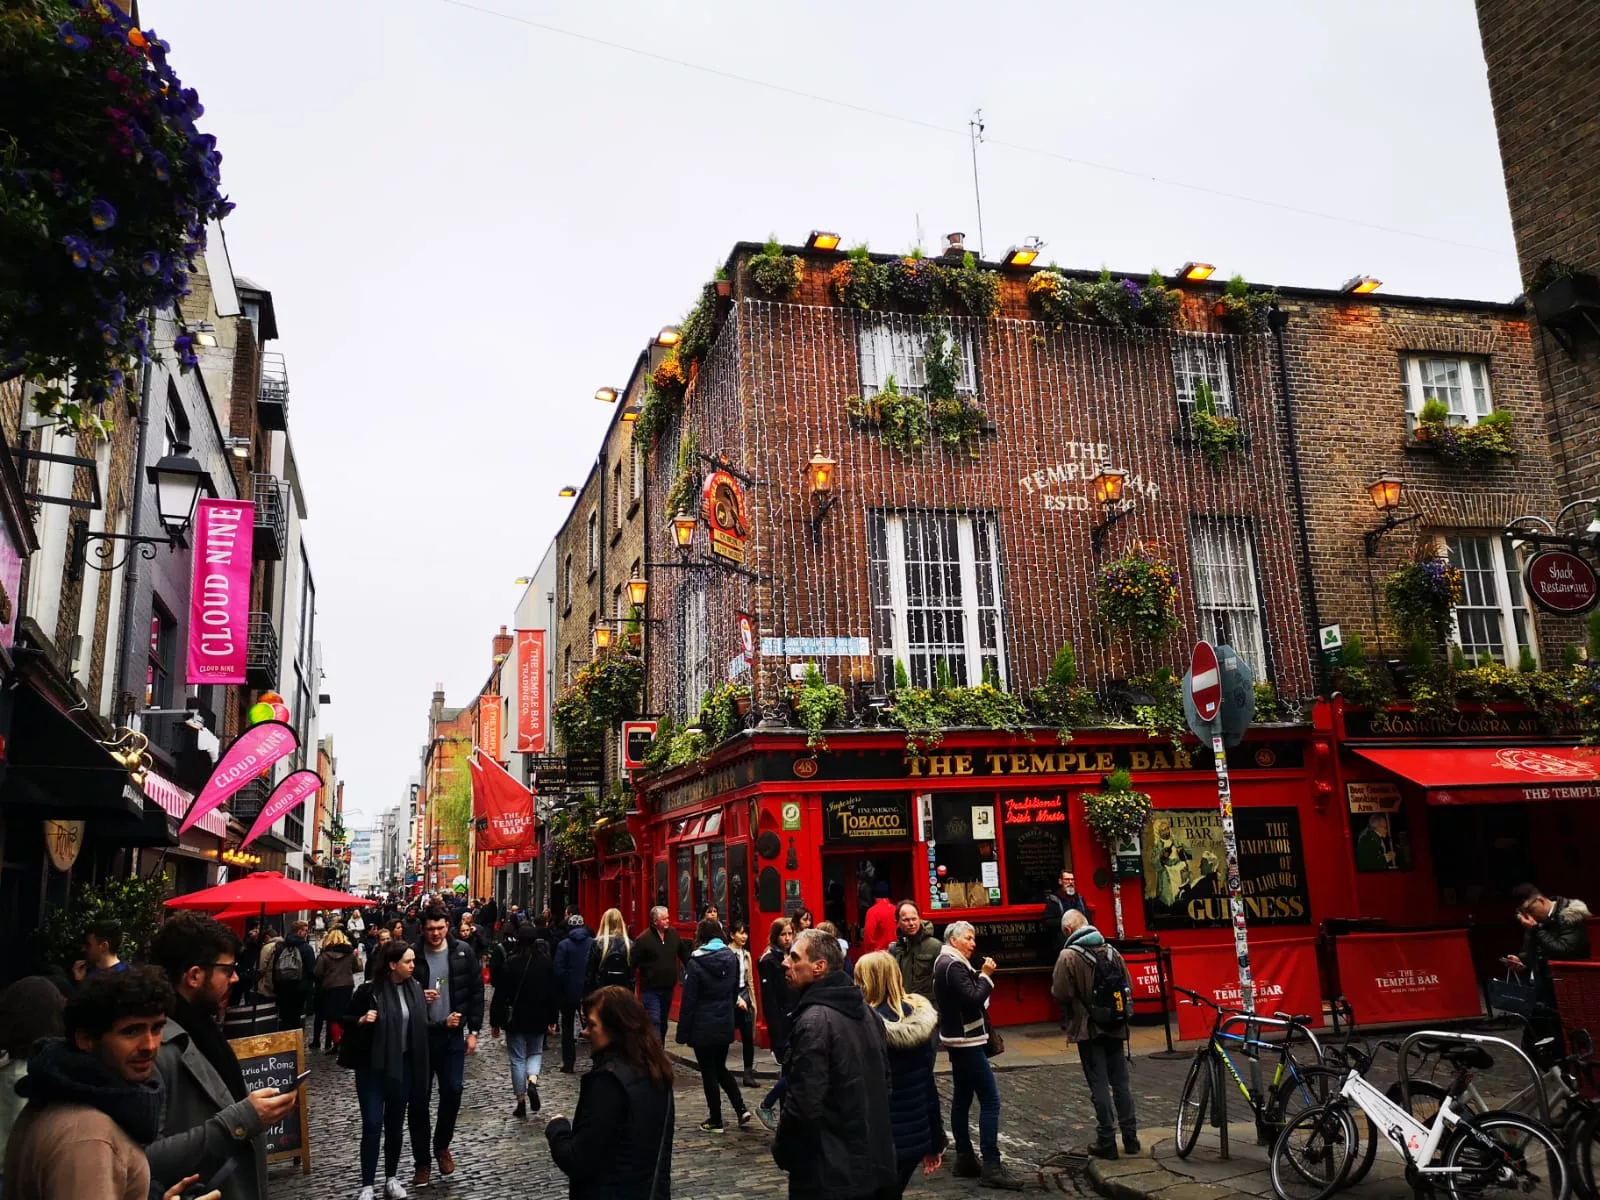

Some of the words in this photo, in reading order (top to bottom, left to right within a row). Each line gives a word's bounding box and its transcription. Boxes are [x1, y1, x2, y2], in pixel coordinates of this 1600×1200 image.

[1066, 442, 1108, 460] THE
[205, 507, 242, 565] NINE
[1540, 581, 1588, 593] Restaurant
[201, 573, 234, 656] CLOUD
[530, 648, 538, 670] THE
[199, 665, 219, 673] CLOUD
[220, 665, 235, 673] NINE
[521, 662, 529, 700] TRADING
[530, 673, 539, 707] TEMPLE
[531, 709, 539, 729] BAR
[214, 754, 257, 788] CLOUD
[255, 729, 288, 757] NINE
[904, 755, 975, 776] THE
[986, 751, 1117, 774] TEMPLE
[1130, 750, 1193, 770] BAR
[798, 760, 813, 773] 48
[1522, 788, 1550, 800] THE
[265, 793, 294, 817] CLOUD
[1004, 795, 1062, 810] Traditional
[492, 816, 532, 828] TEMPLE
[502, 812, 520, 820] THE
[836, 810, 900, 835] TOBACCO
[1004, 809, 1031, 824] Irish
[503, 826, 524, 835] BAR
[1185, 827, 1213, 841] BAR
[1265, 822, 1289, 838] THE
[1240, 839, 1292, 855] EMPEROR
[1279, 855, 1292, 871] OF
[1187, 896, 1304, 921] GUINESS
[1144, 965, 1158, 975] TH
[1398, 969, 1414, 977] THE
[1375, 976, 1416, 988] TEMPLE
[1417, 974, 1439, 985] BAR
[1148, 985, 1160, 994] BA
[1260, 984, 1284, 996] BAR
[269, 1057, 295, 1071] Rome
[267, 1073, 293, 1087] Deal
